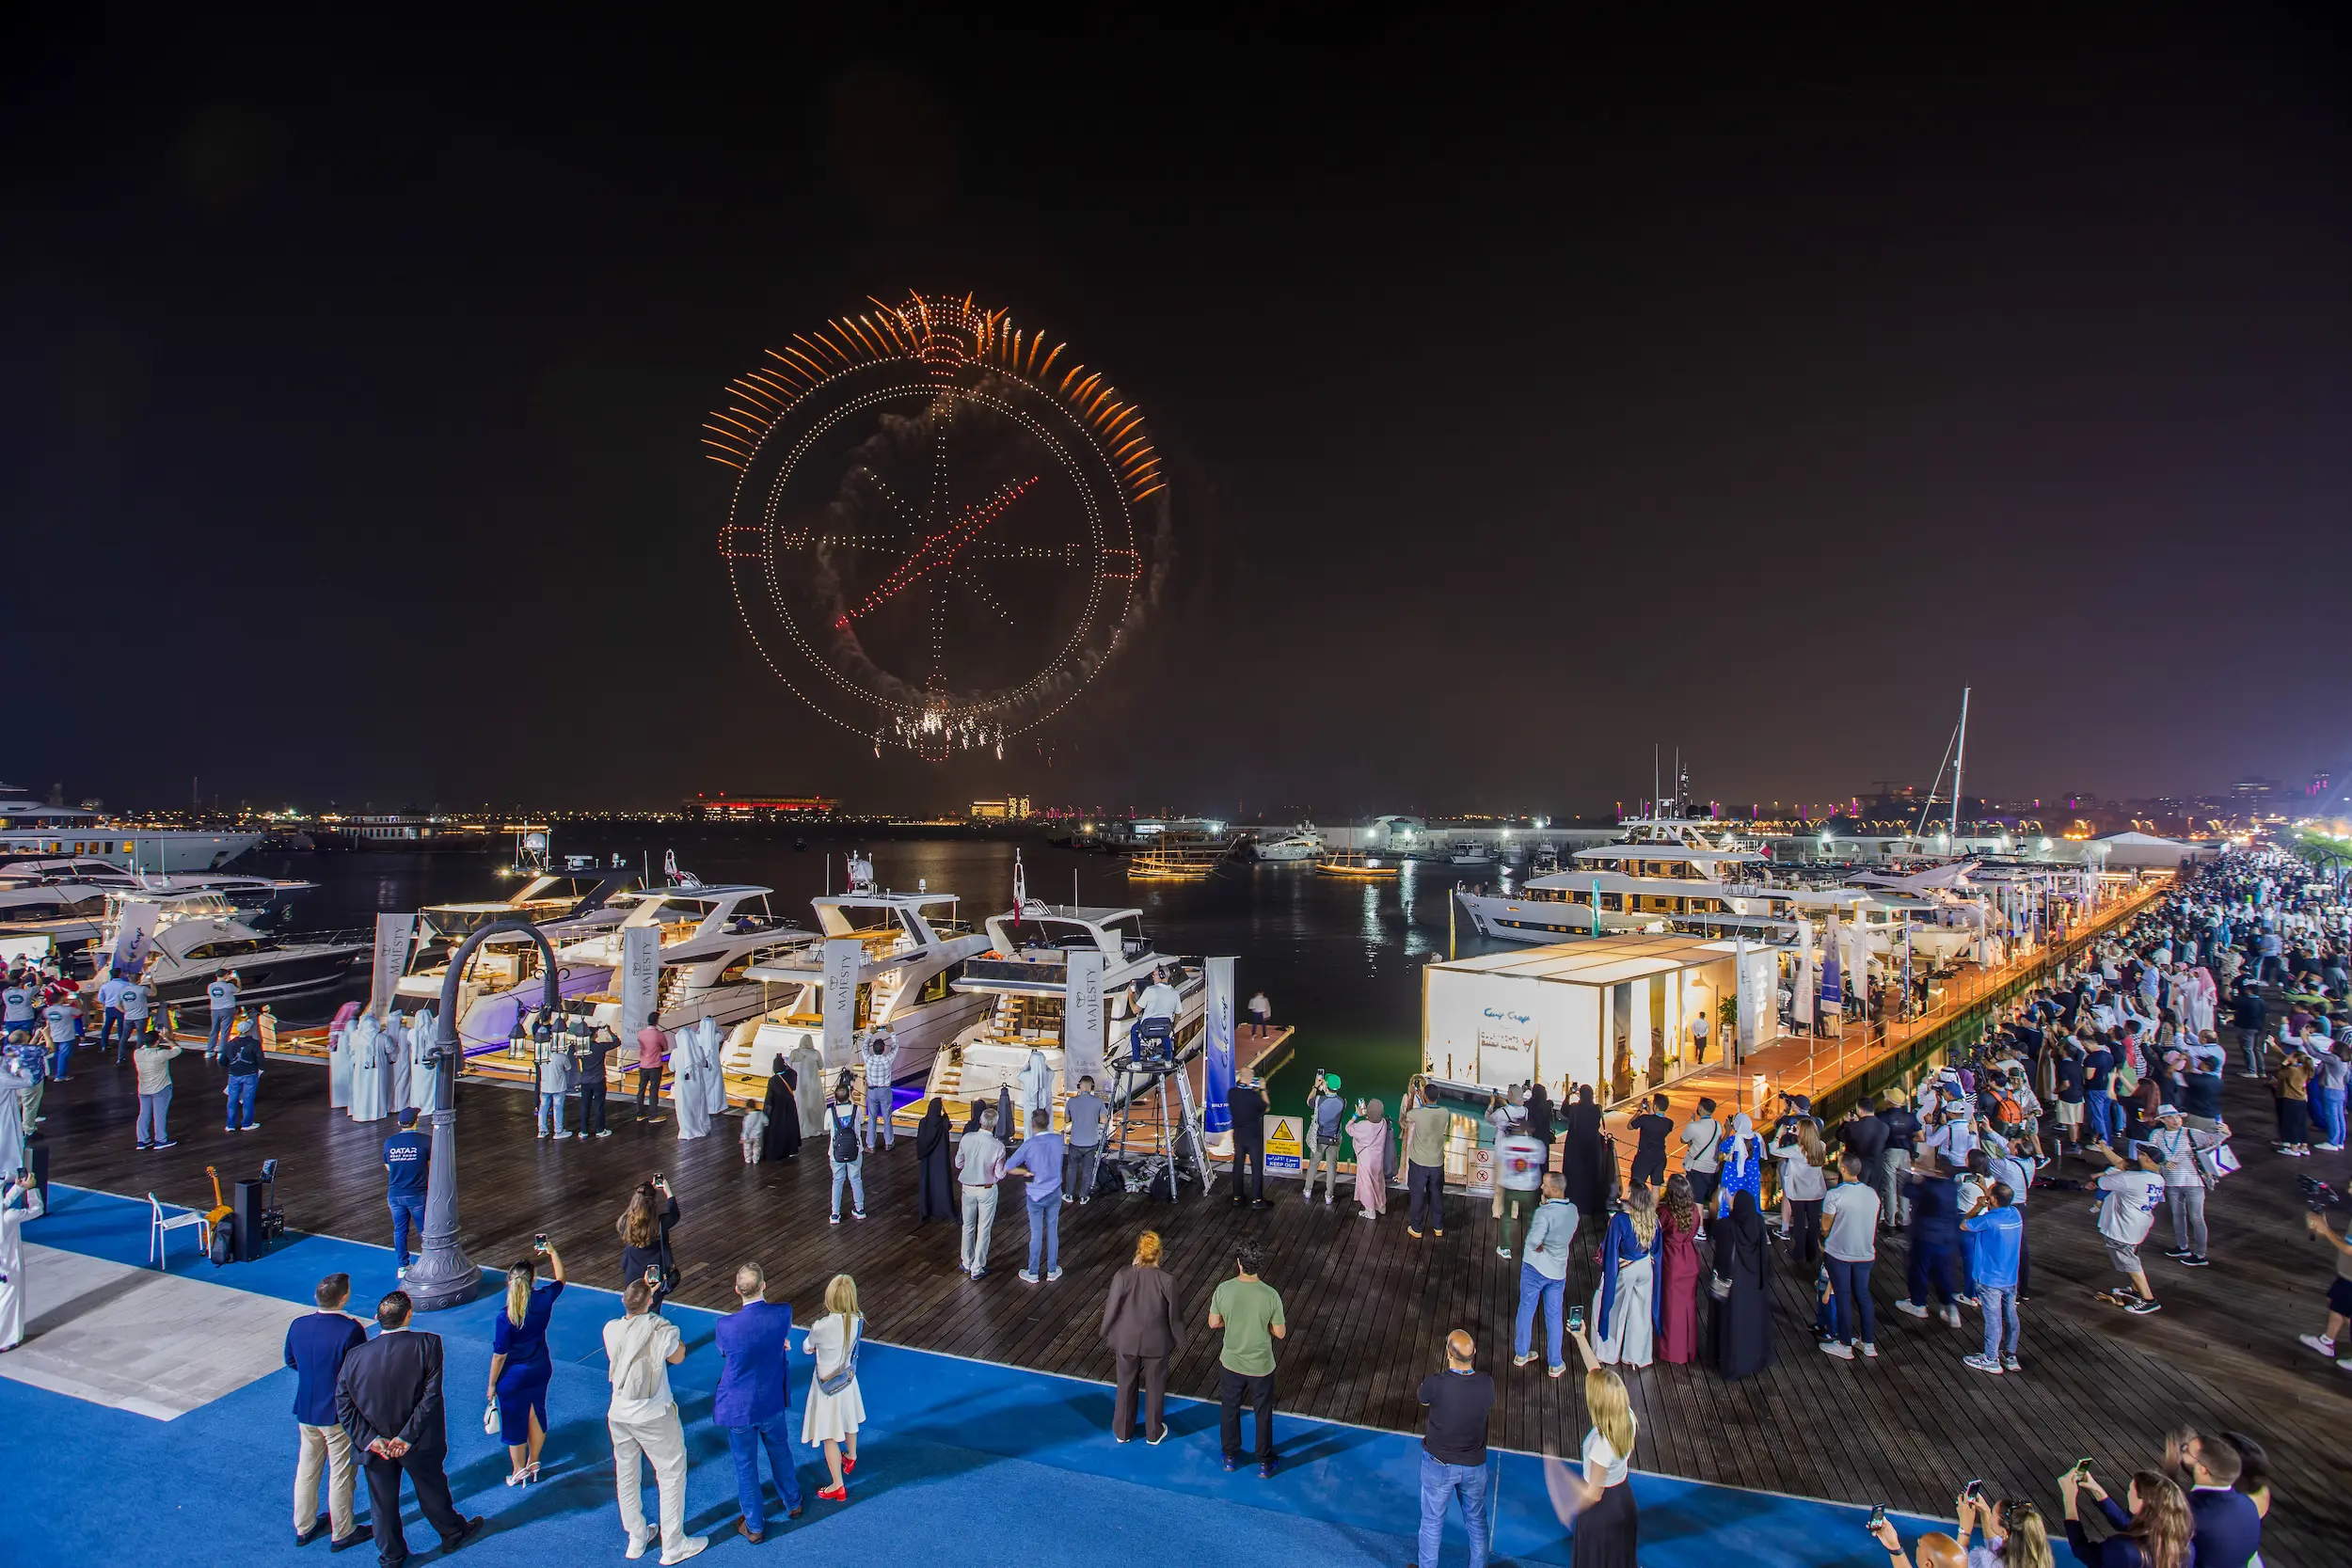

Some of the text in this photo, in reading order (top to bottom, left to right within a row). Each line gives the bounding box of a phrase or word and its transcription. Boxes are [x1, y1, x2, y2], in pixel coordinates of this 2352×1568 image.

[781, 525, 808, 550] W
[389, 927, 405, 975] MAJESTY
[643, 942, 655, 996] MAJESTY
[837, 955, 851, 1011] MAJESTY
[1087, 968, 1099, 1031] MAJESTY
[389, 1147, 418, 1155] QATAR
